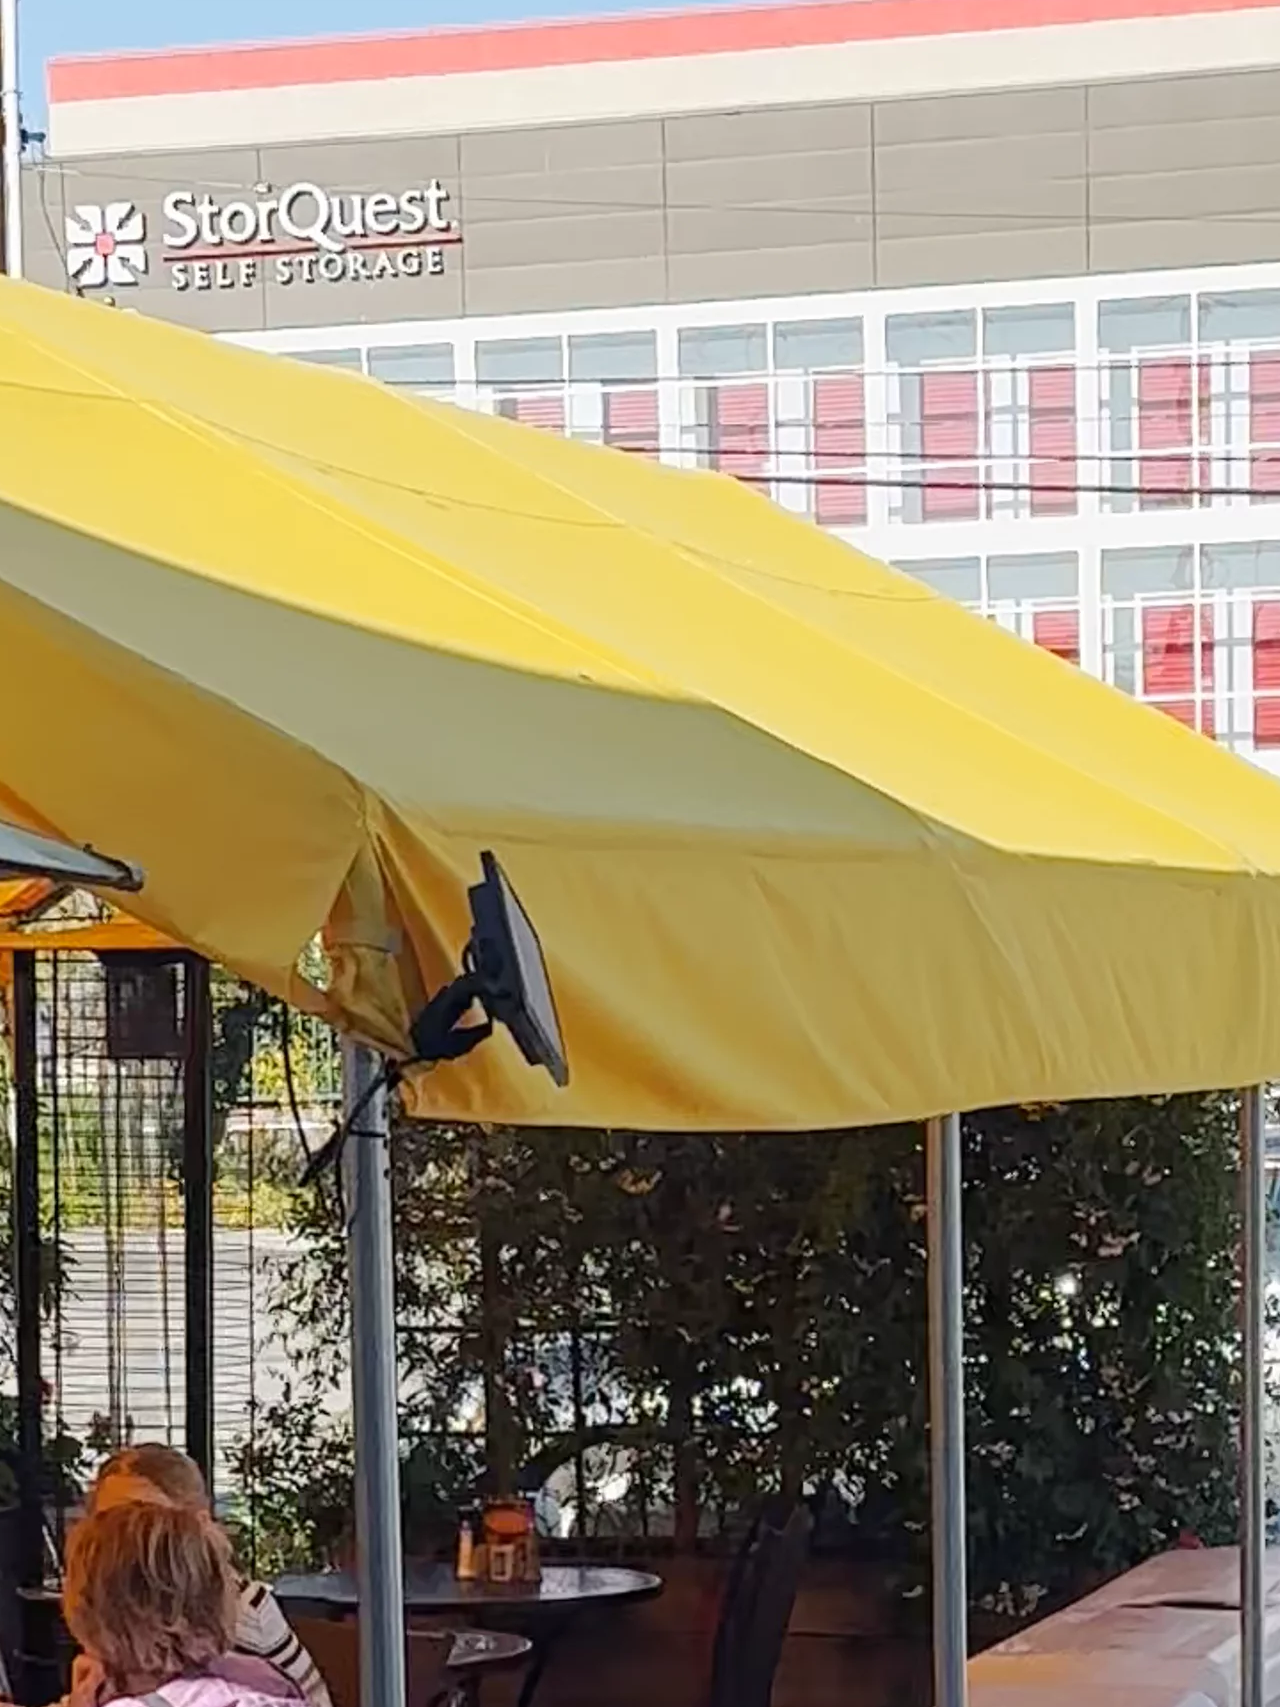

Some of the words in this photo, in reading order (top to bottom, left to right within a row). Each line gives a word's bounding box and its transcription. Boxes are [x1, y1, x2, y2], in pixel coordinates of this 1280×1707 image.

[162, 179, 454, 252] StorQuest
[171, 260, 258, 291] SELF
[276, 248, 445, 284] STORAGE
